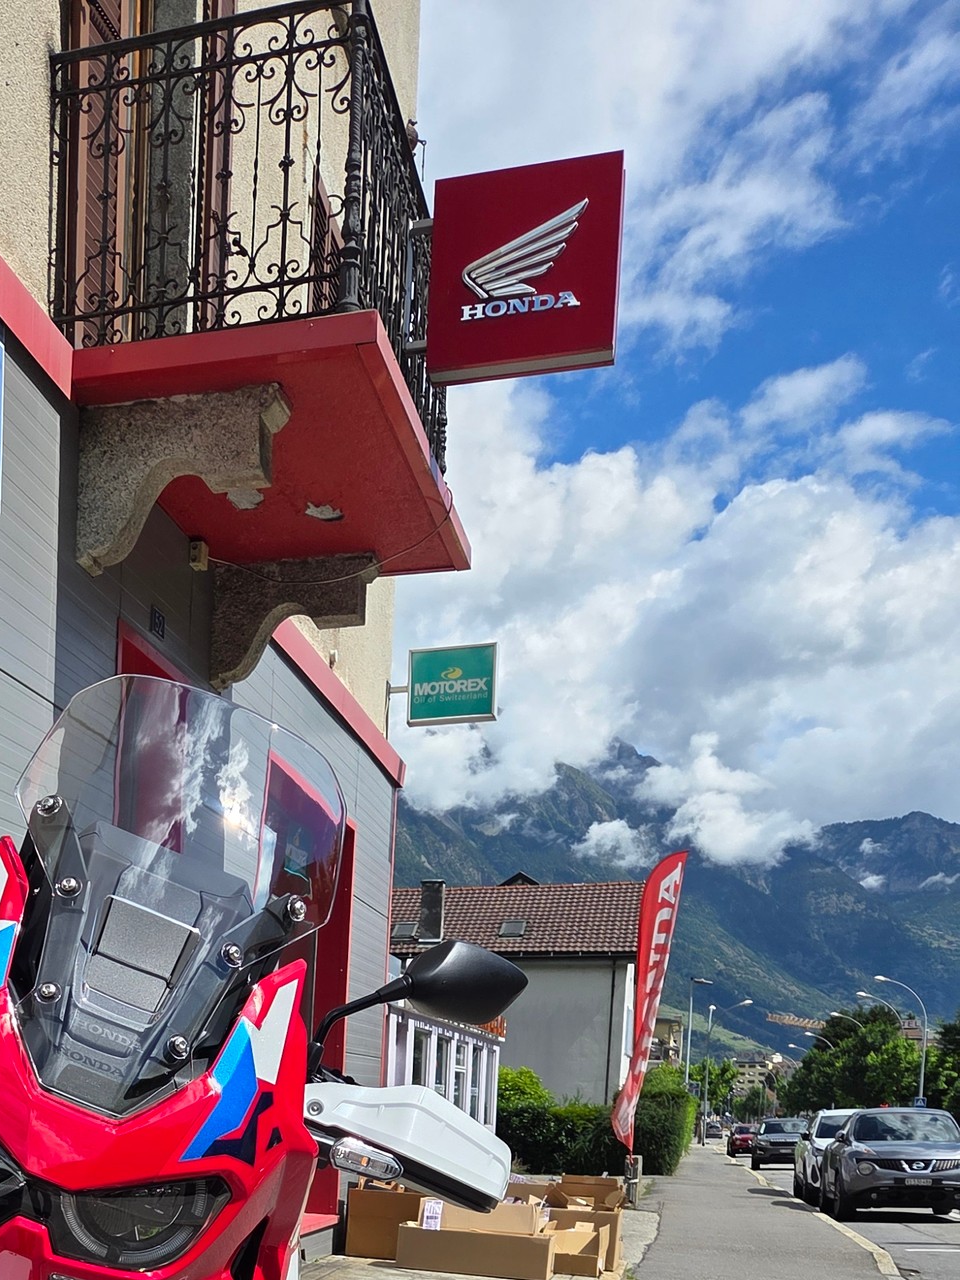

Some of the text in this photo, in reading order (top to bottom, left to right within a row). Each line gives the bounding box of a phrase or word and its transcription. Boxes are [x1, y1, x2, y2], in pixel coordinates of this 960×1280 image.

[460, 291, 580, 321] HONDA
[414, 678, 488, 696] MOTOREX
[413, 691, 488, 704] Oil of Switzerland
